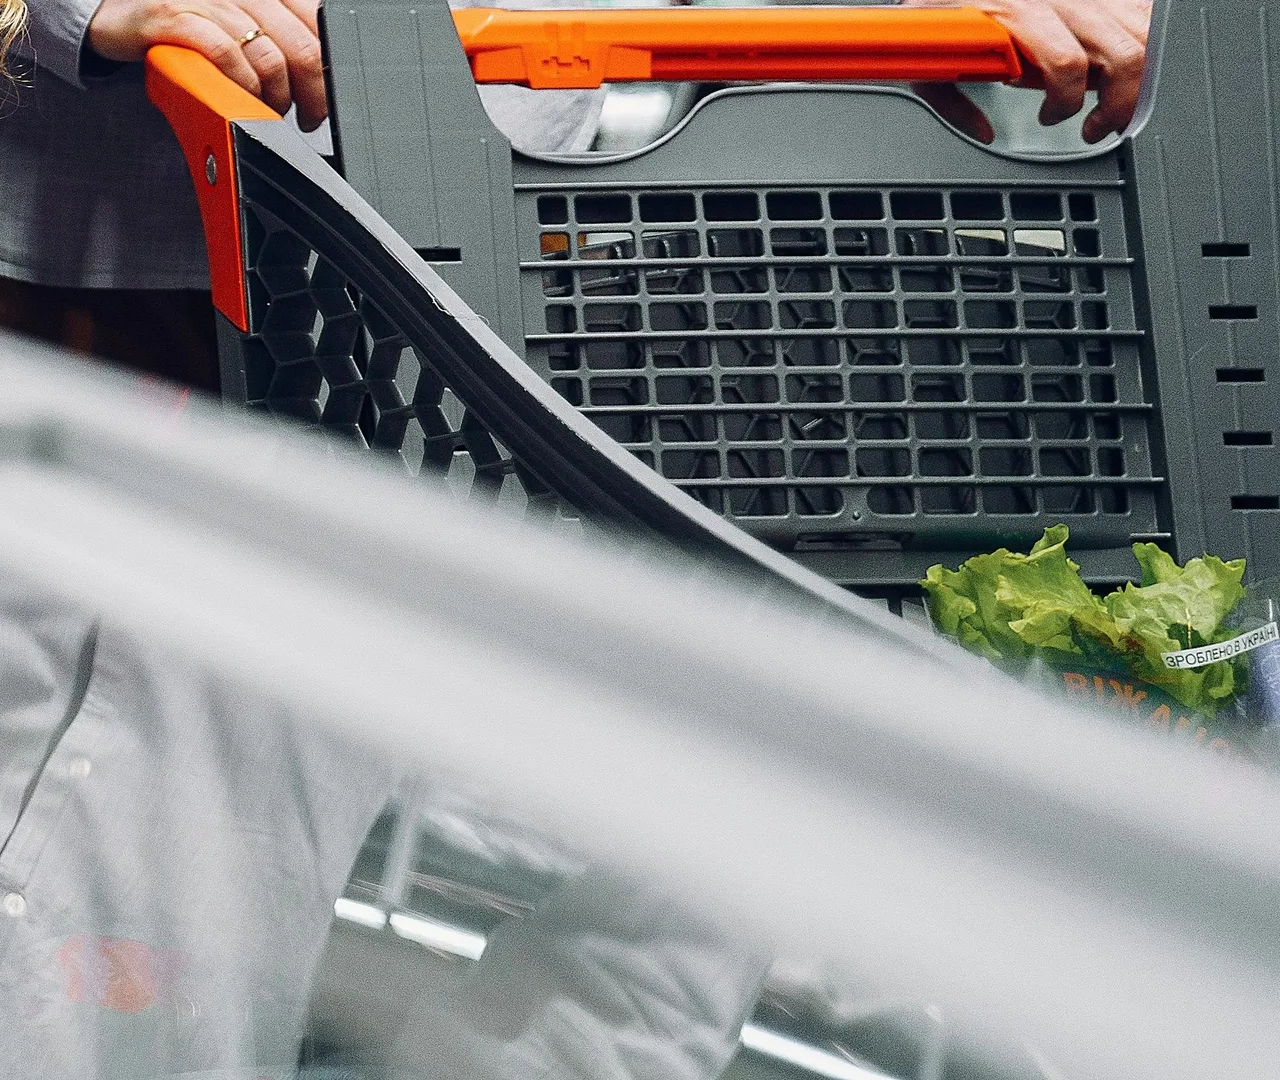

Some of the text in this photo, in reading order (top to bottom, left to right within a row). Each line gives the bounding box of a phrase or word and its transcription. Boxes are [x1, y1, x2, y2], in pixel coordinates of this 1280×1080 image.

[1165, 626, 1277, 668] ЗРОБЛЕНО В УКРАЇНІ
